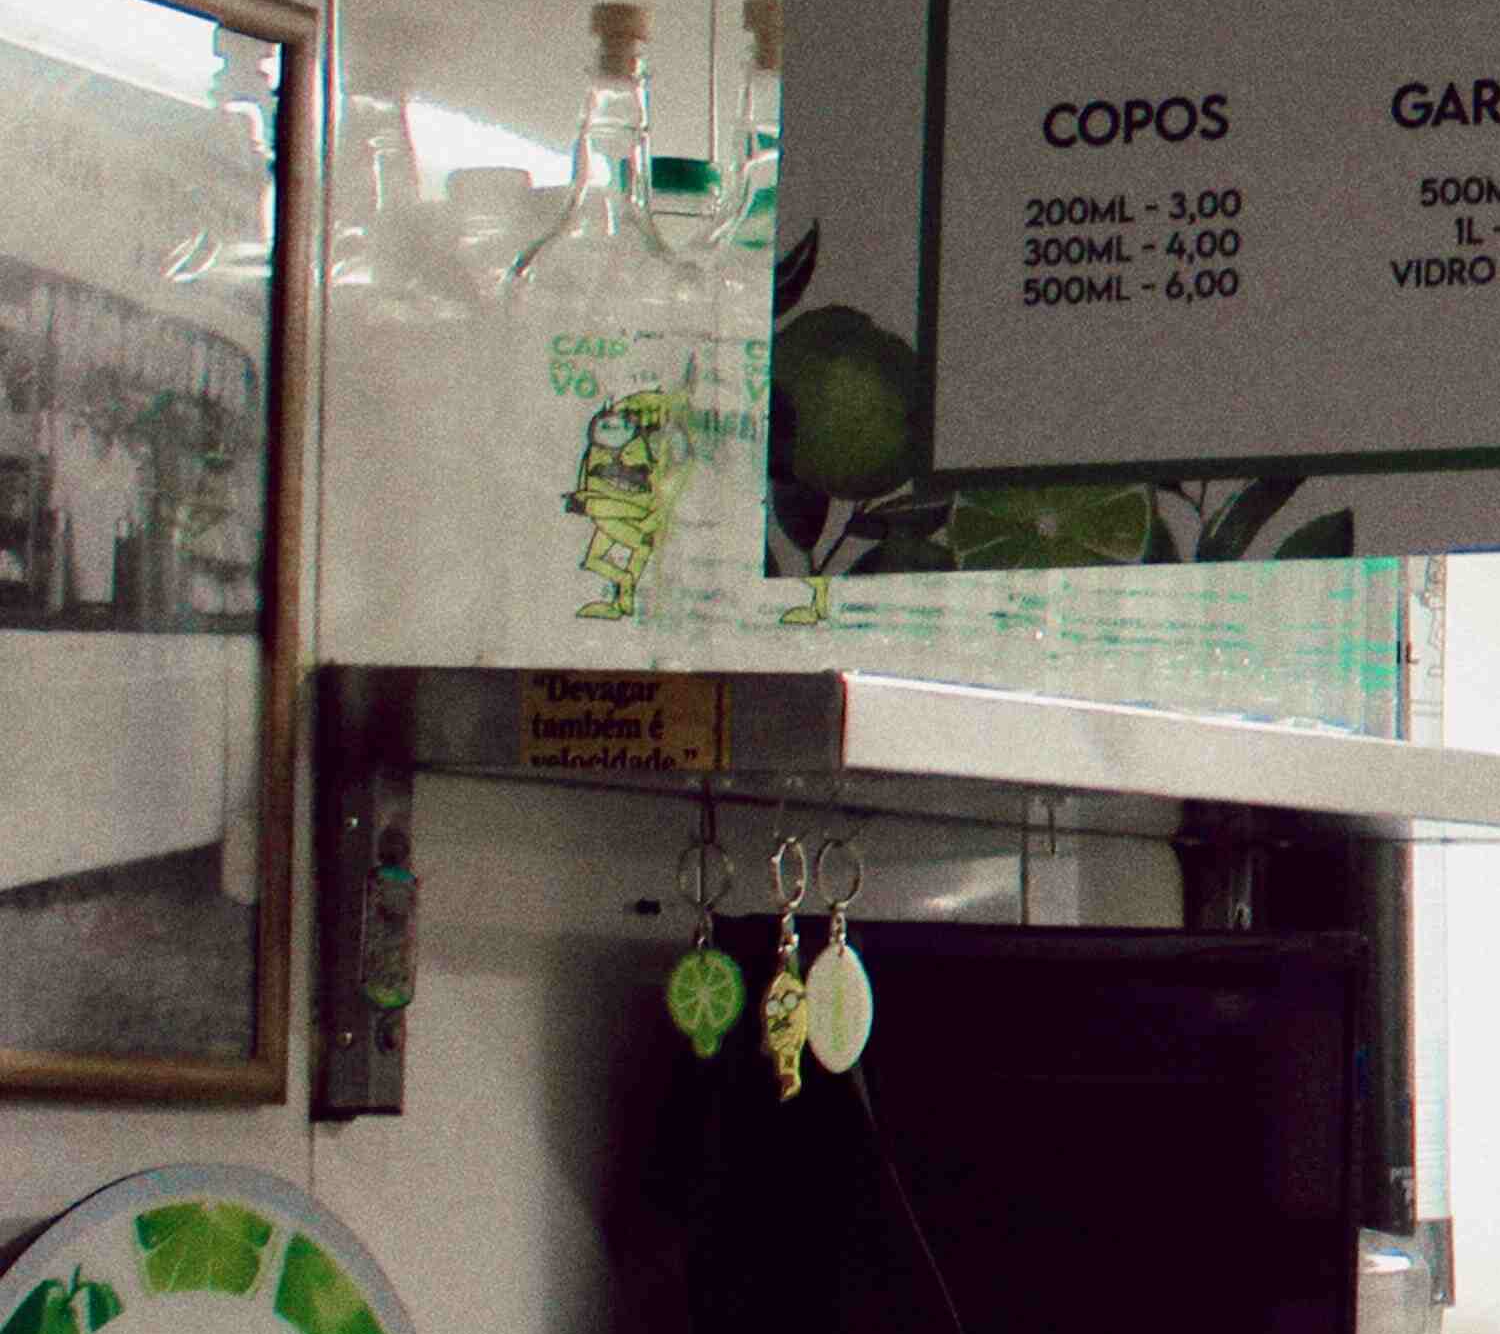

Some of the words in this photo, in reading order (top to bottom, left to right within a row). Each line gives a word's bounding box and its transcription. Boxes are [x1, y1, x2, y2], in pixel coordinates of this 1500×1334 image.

[1041, 93, 1230, 149] COPOS
[1025, 194, 1135, 229] 200ML
[1168, 188, 1243, 224] 3,00
[1023, 235, 1133, 268] 300ML
[1164, 228, 1242, 263] 4,00
[1454, 216, 1484, 246] 1L
[1022, 275, 1131, 308] 500ML
[1164, 267, 1241, 305] 6,00
[1389, 255, 1497, 289] VIDRO
[532, 710, 642, 739] também
[648, 710, 664, 739] é
